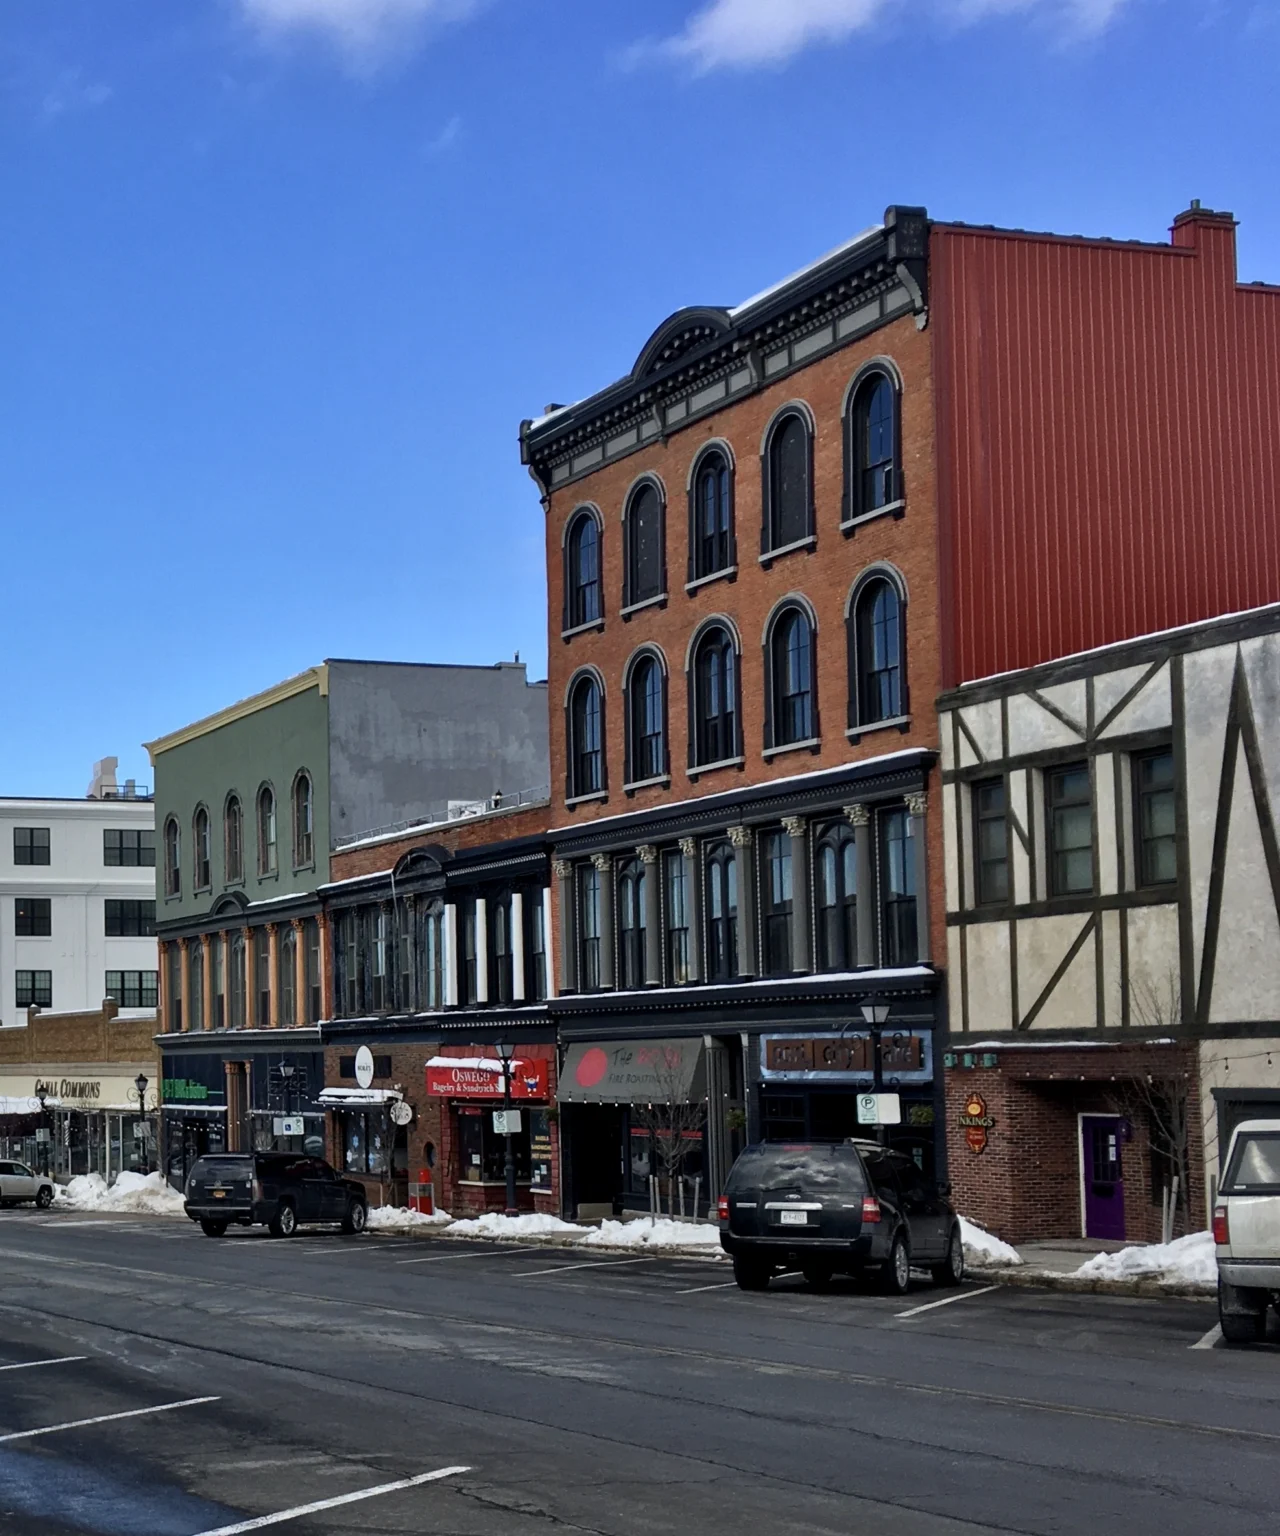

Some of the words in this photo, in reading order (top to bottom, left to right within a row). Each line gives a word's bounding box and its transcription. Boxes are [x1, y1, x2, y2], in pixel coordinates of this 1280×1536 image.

[452, 1068, 490, 1083] OSWEGO
[60, 1079, 101, 1098] COMMONS
[433, 1082, 456, 1093] Bagelry
[456, 1083, 462, 1092] &
[462, 1083, 494, 1093] Sandwich
